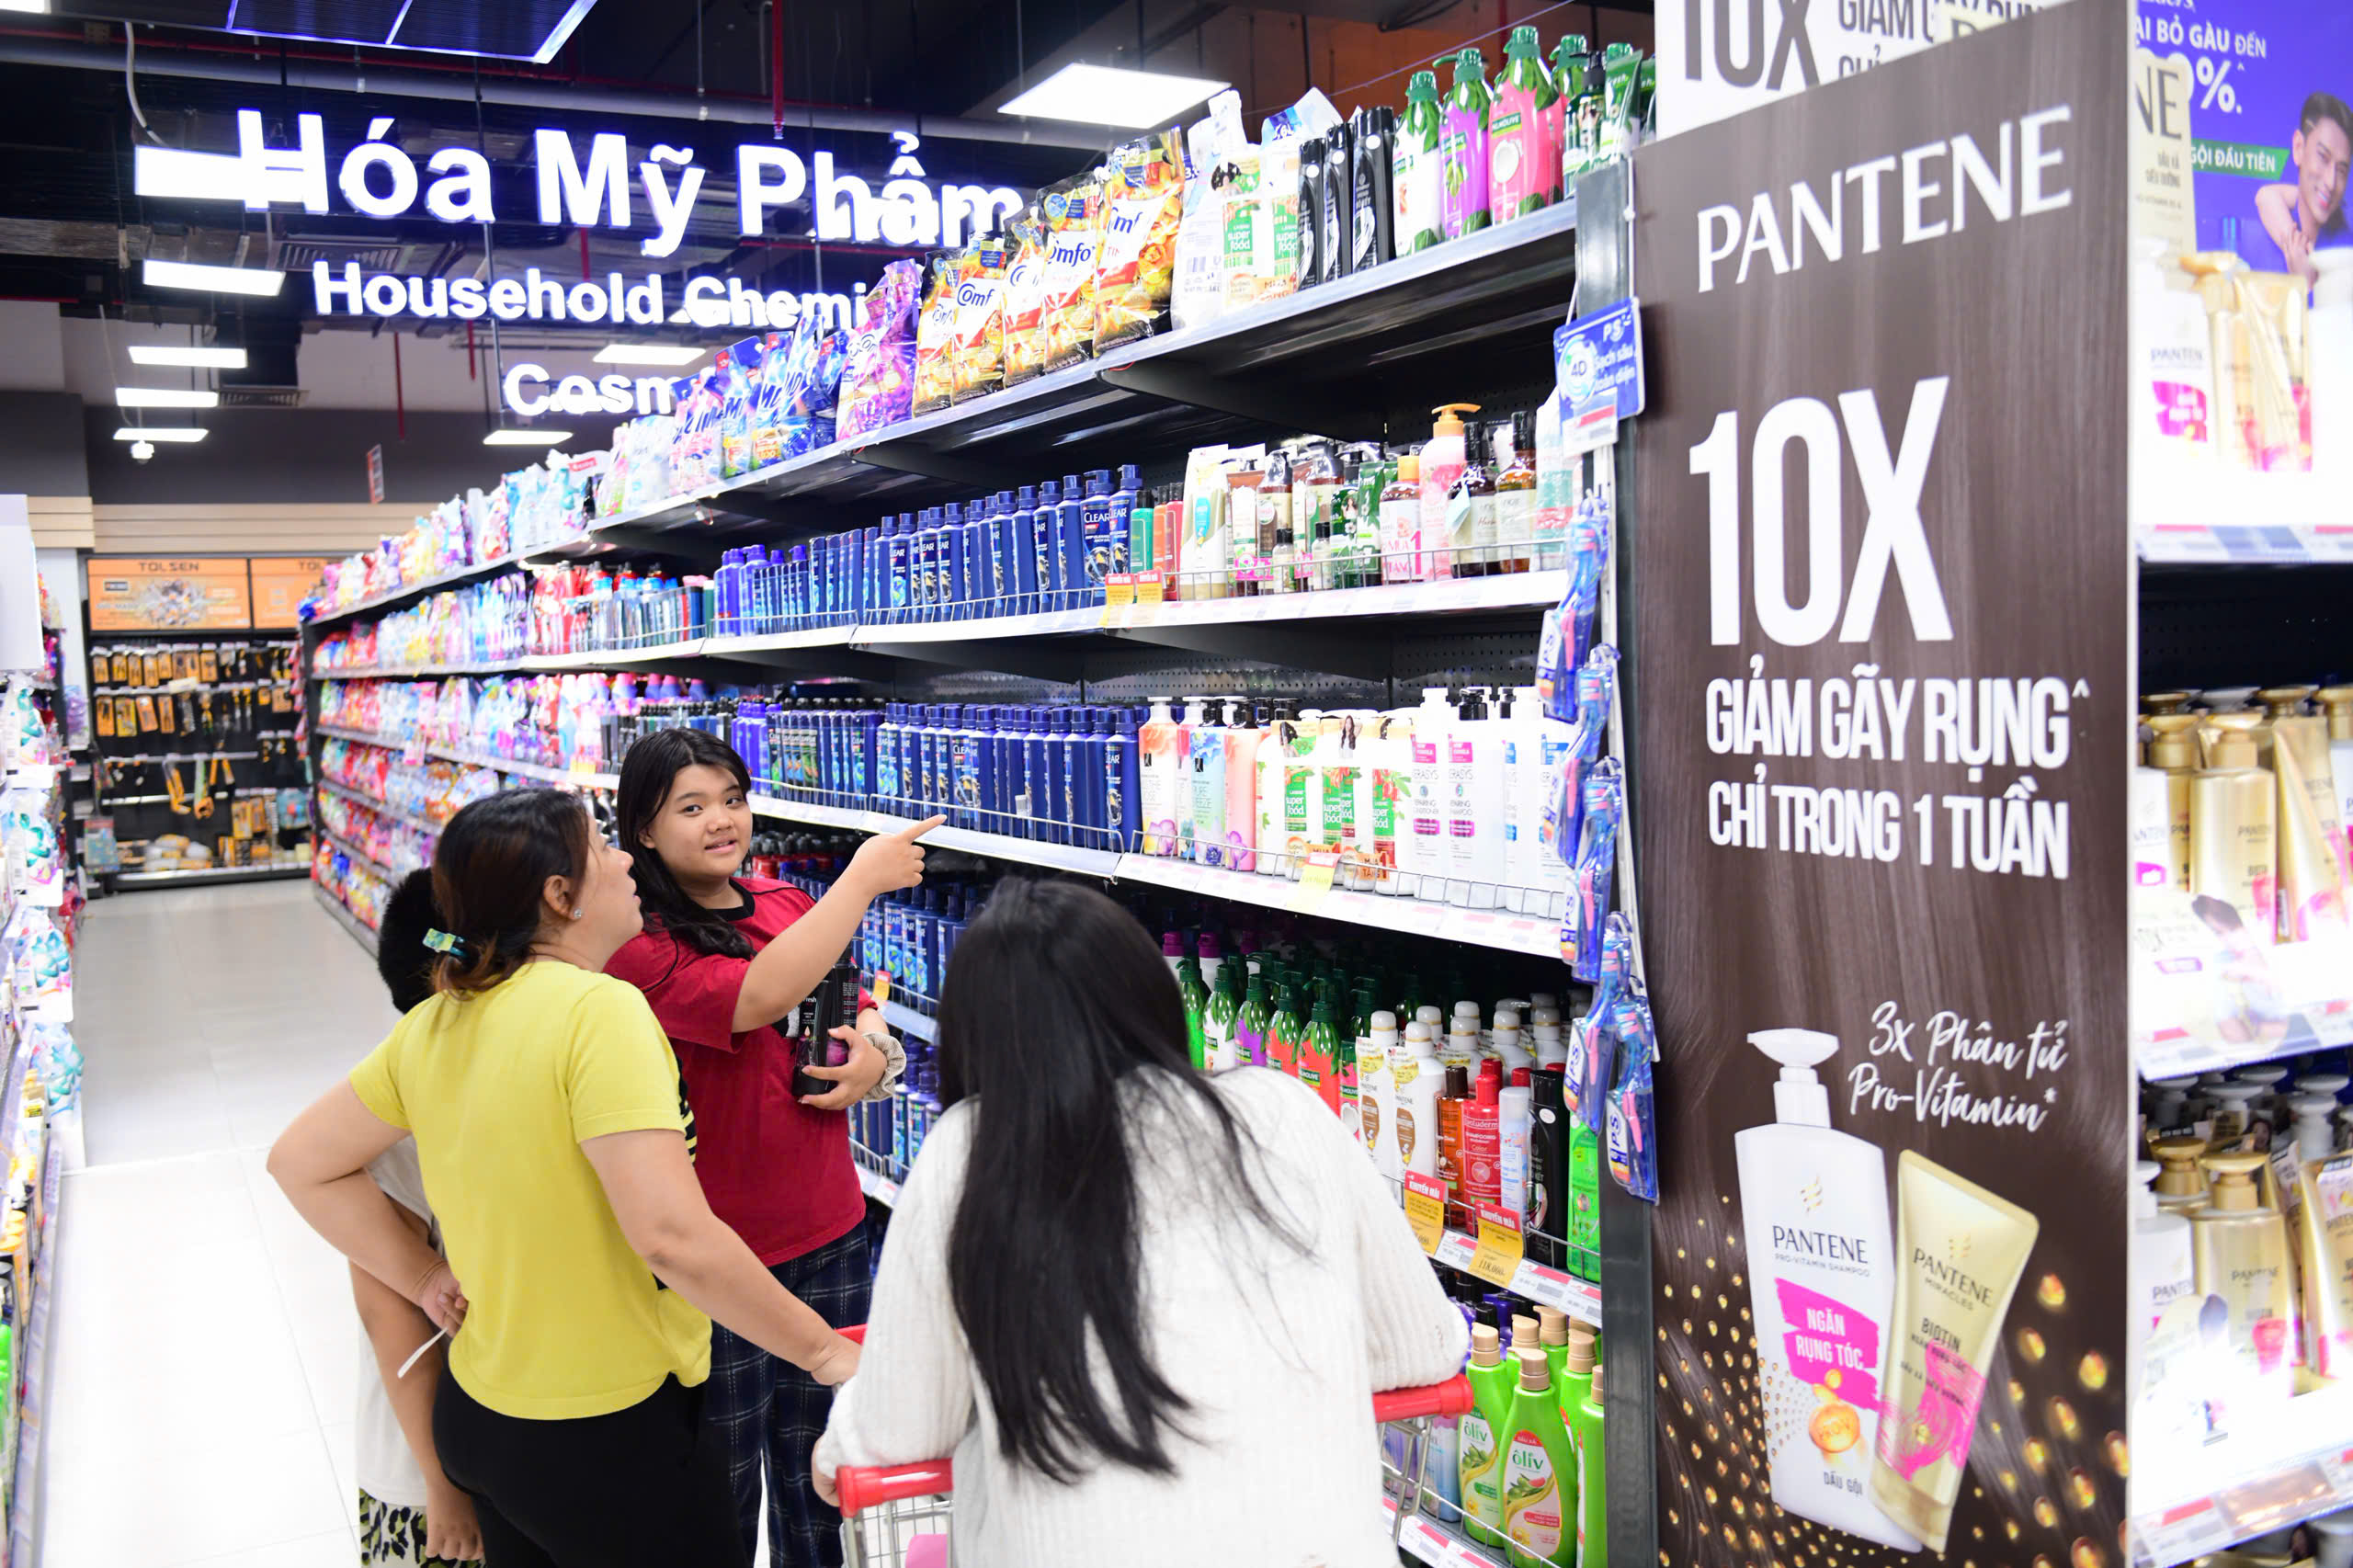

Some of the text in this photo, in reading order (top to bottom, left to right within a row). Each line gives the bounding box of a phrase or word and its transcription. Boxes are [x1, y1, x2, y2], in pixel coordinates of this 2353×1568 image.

[2156, 15, 2184, 46] BỎ
[2189, 22, 2230, 53] GÀU
[2214, 147, 2244, 169] ĐẦU
[2246, 150, 2277, 173] TIÊN
[238, 109, 1024, 258] Hóa Mỹ Phẩm
[1698, 105, 2073, 292] PANTENE
[313, 261, 664, 324] Household
[1084, 512, 1110, 523] CLEAR
[1688, 375, 1954, 646] 10X
[139, 562, 199, 573] TOLSEN
[1706, 653, 1813, 757] GIẢM
[1820, 663, 1916, 761] GÃY
[1708, 762, 2069, 880] CHỈ TRONG 1 TUẦN
[1926, 1011, 2025, 1072] Phân
[2026, 1019, 2069, 1080] tử
[1772, 1225, 1869, 1265] PANTENE
[1828, 1261, 1870, 1278] SHAMPOO
[1913, 1247, 1994, 1308] PANTENE
[1925, 1277, 1974, 1312] MIRACLES
[1806, 1307, 1845, 1337] NGĂN
[1921, 1317, 1961, 1353] BIOTIN
[1796, 1336, 1864, 1370] RỤNG TÓC
[1463, 1421, 1487, 1442] ôliv
[1512, 1449, 1544, 1470] ôliv
